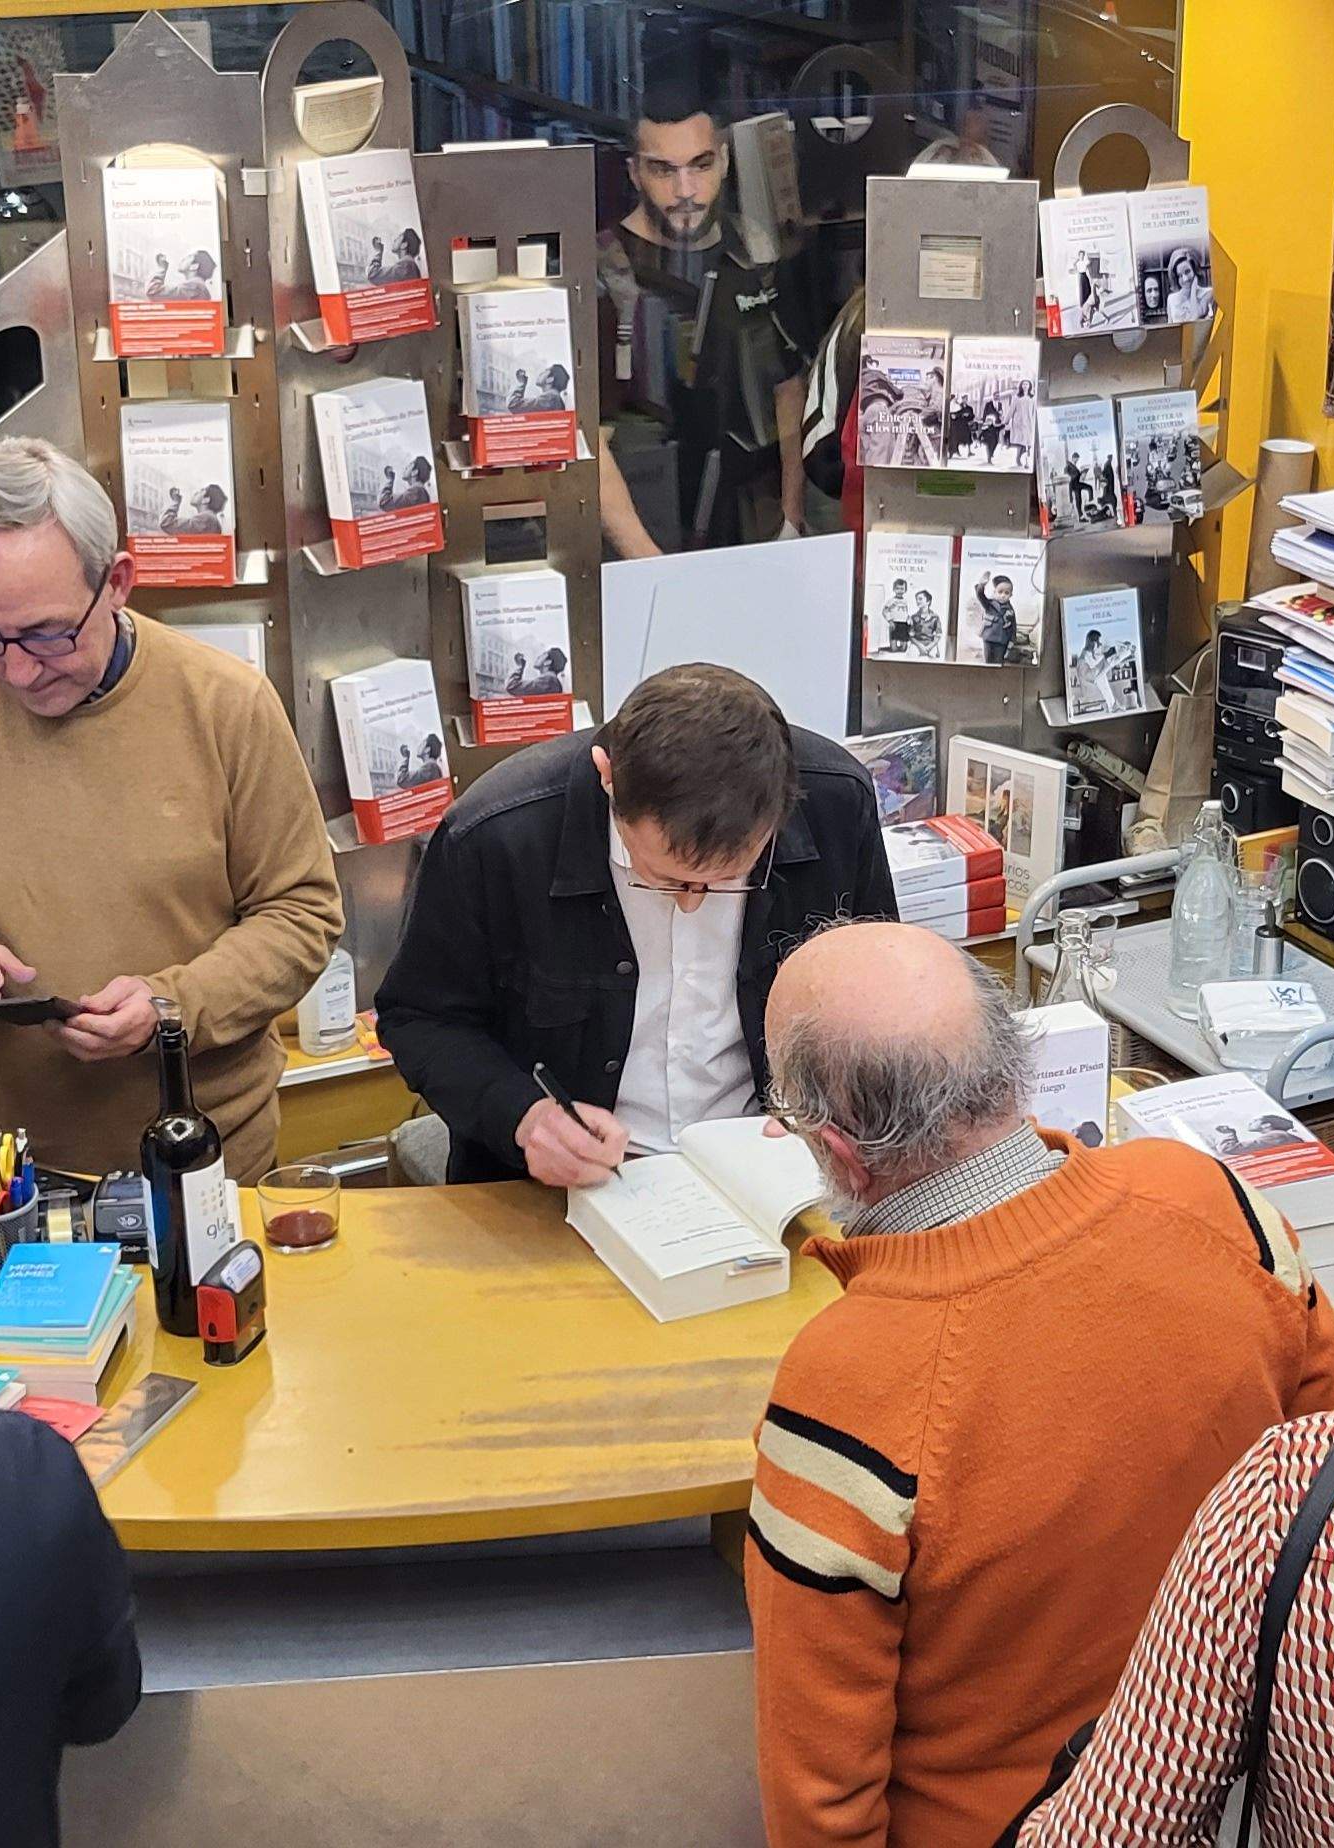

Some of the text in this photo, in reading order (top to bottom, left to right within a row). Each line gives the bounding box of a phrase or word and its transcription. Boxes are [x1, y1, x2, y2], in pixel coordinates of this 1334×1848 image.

[1066, 1066, 1077, 1075] de
[1040, 1083, 1066, 1094] fuego
[5, 1270, 56, 1278] JAMES
